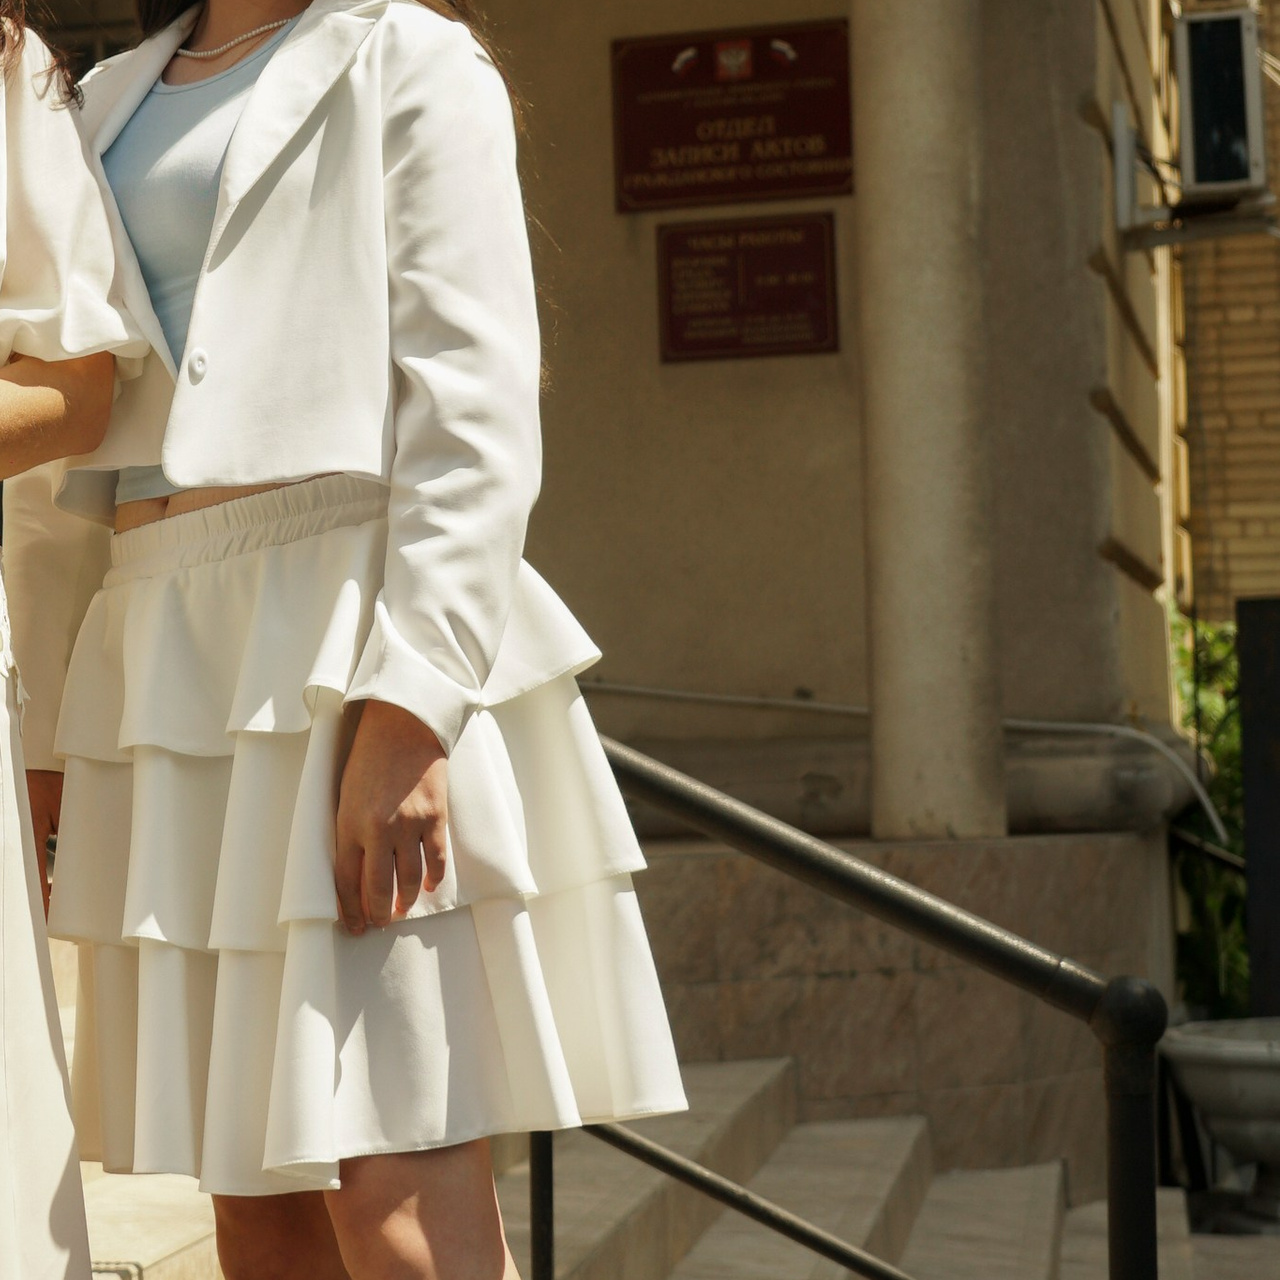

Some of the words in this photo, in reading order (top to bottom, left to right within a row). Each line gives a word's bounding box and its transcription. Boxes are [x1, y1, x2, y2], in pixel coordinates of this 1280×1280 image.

[695, 115, 777, 142] ОТДЕЛ
[649, 140, 741, 170] ЗАПИСИ
[750, 133, 828, 162] АКТОВ
